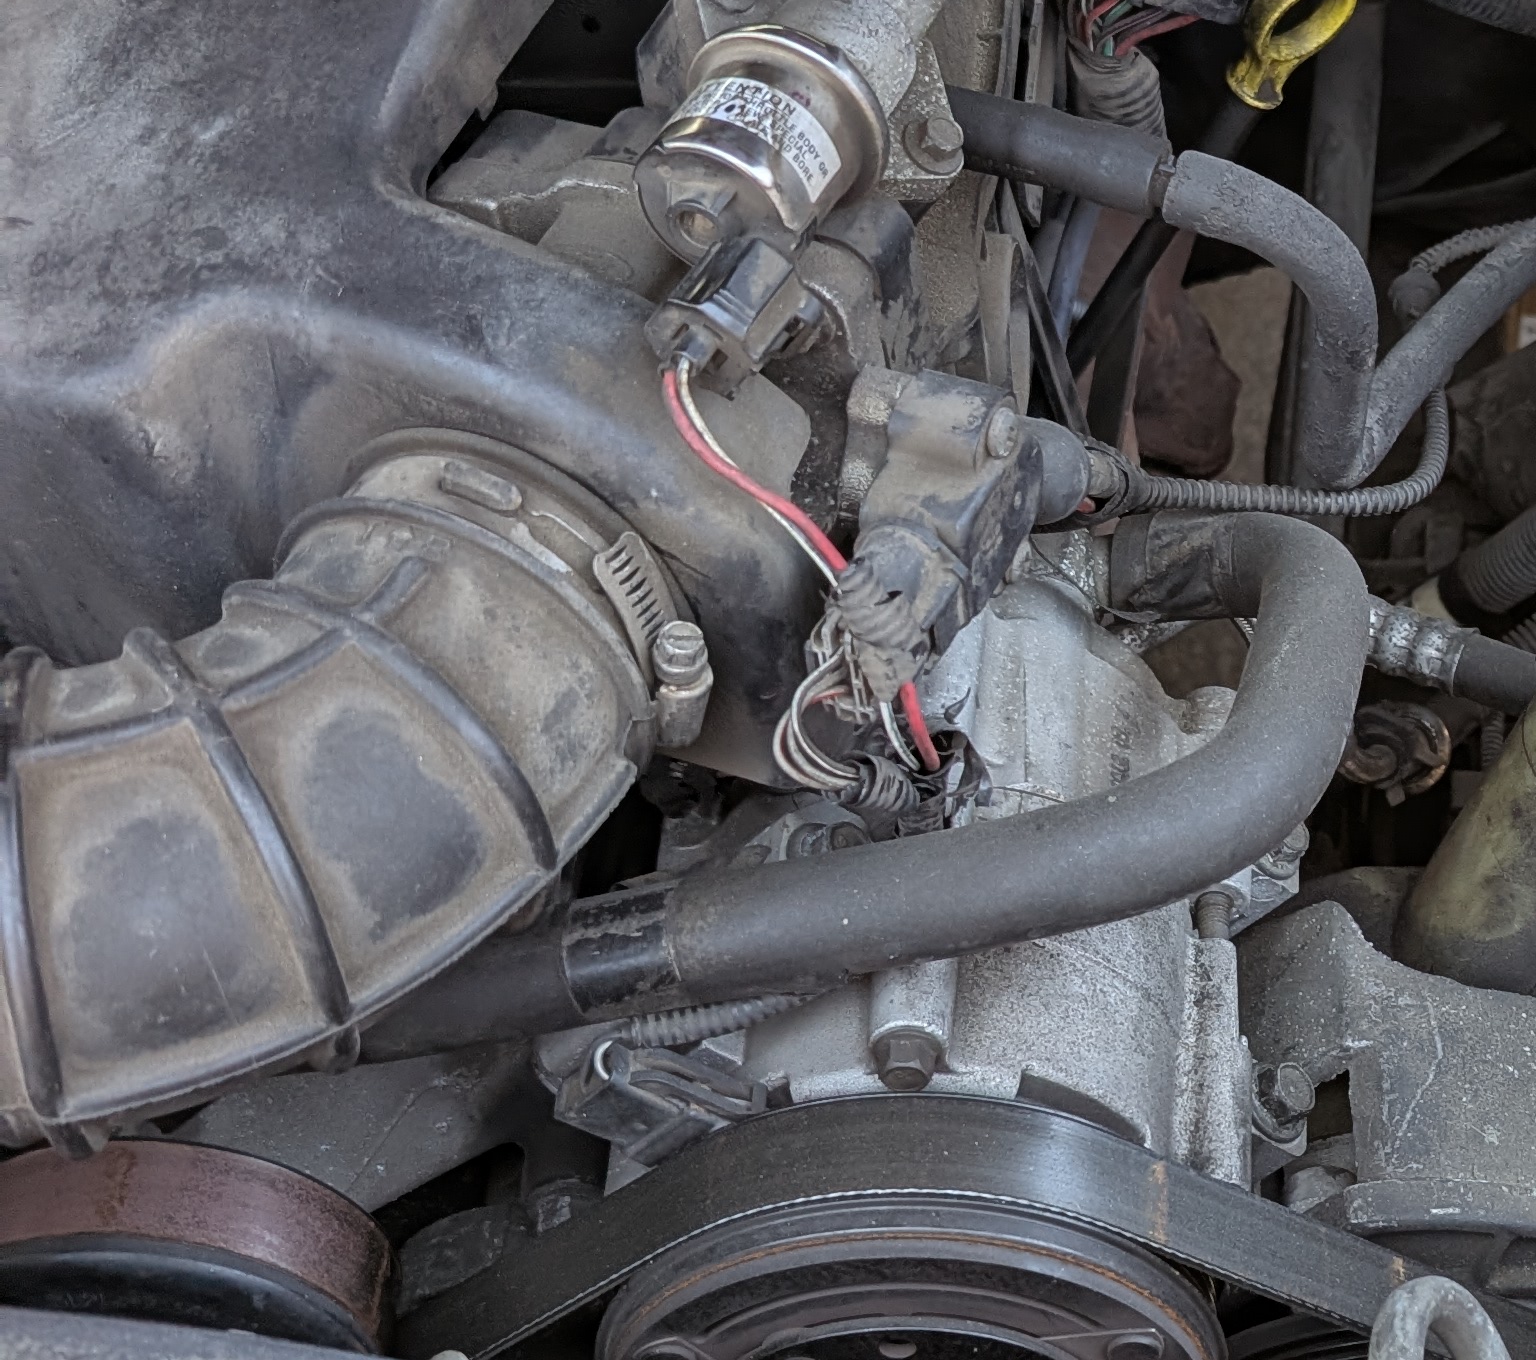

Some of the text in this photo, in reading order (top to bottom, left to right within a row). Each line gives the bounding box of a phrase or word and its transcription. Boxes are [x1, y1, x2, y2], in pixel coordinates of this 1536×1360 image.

[792, 153, 814, 182] BORE
[797, 131, 820, 160] BODY
[818, 161, 829, 179] OR
